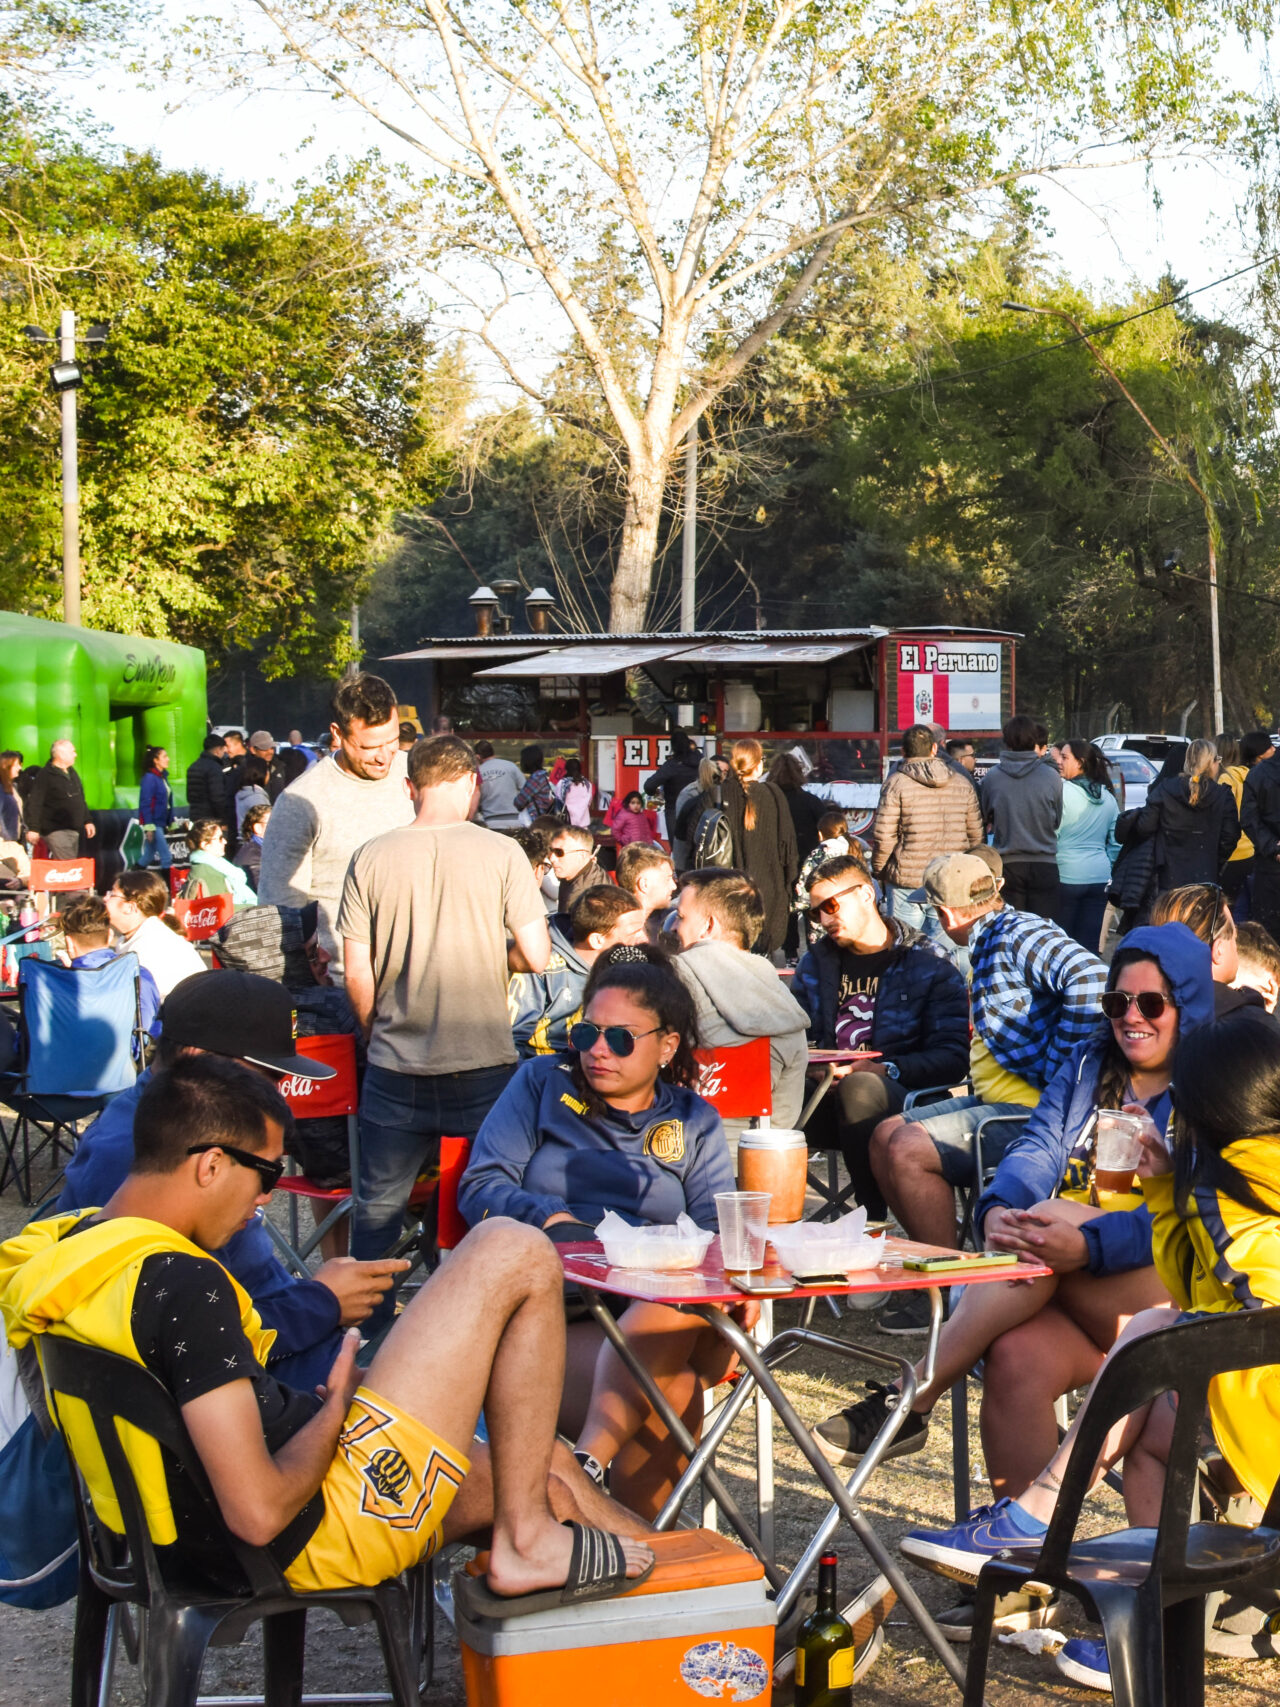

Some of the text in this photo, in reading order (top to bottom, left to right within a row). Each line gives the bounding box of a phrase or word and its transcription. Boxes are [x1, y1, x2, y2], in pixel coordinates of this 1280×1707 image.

[900, 644, 999, 672] El Peruano
[623, 739, 650, 767] El
[183, 906, 219, 929] Coca-Cola
